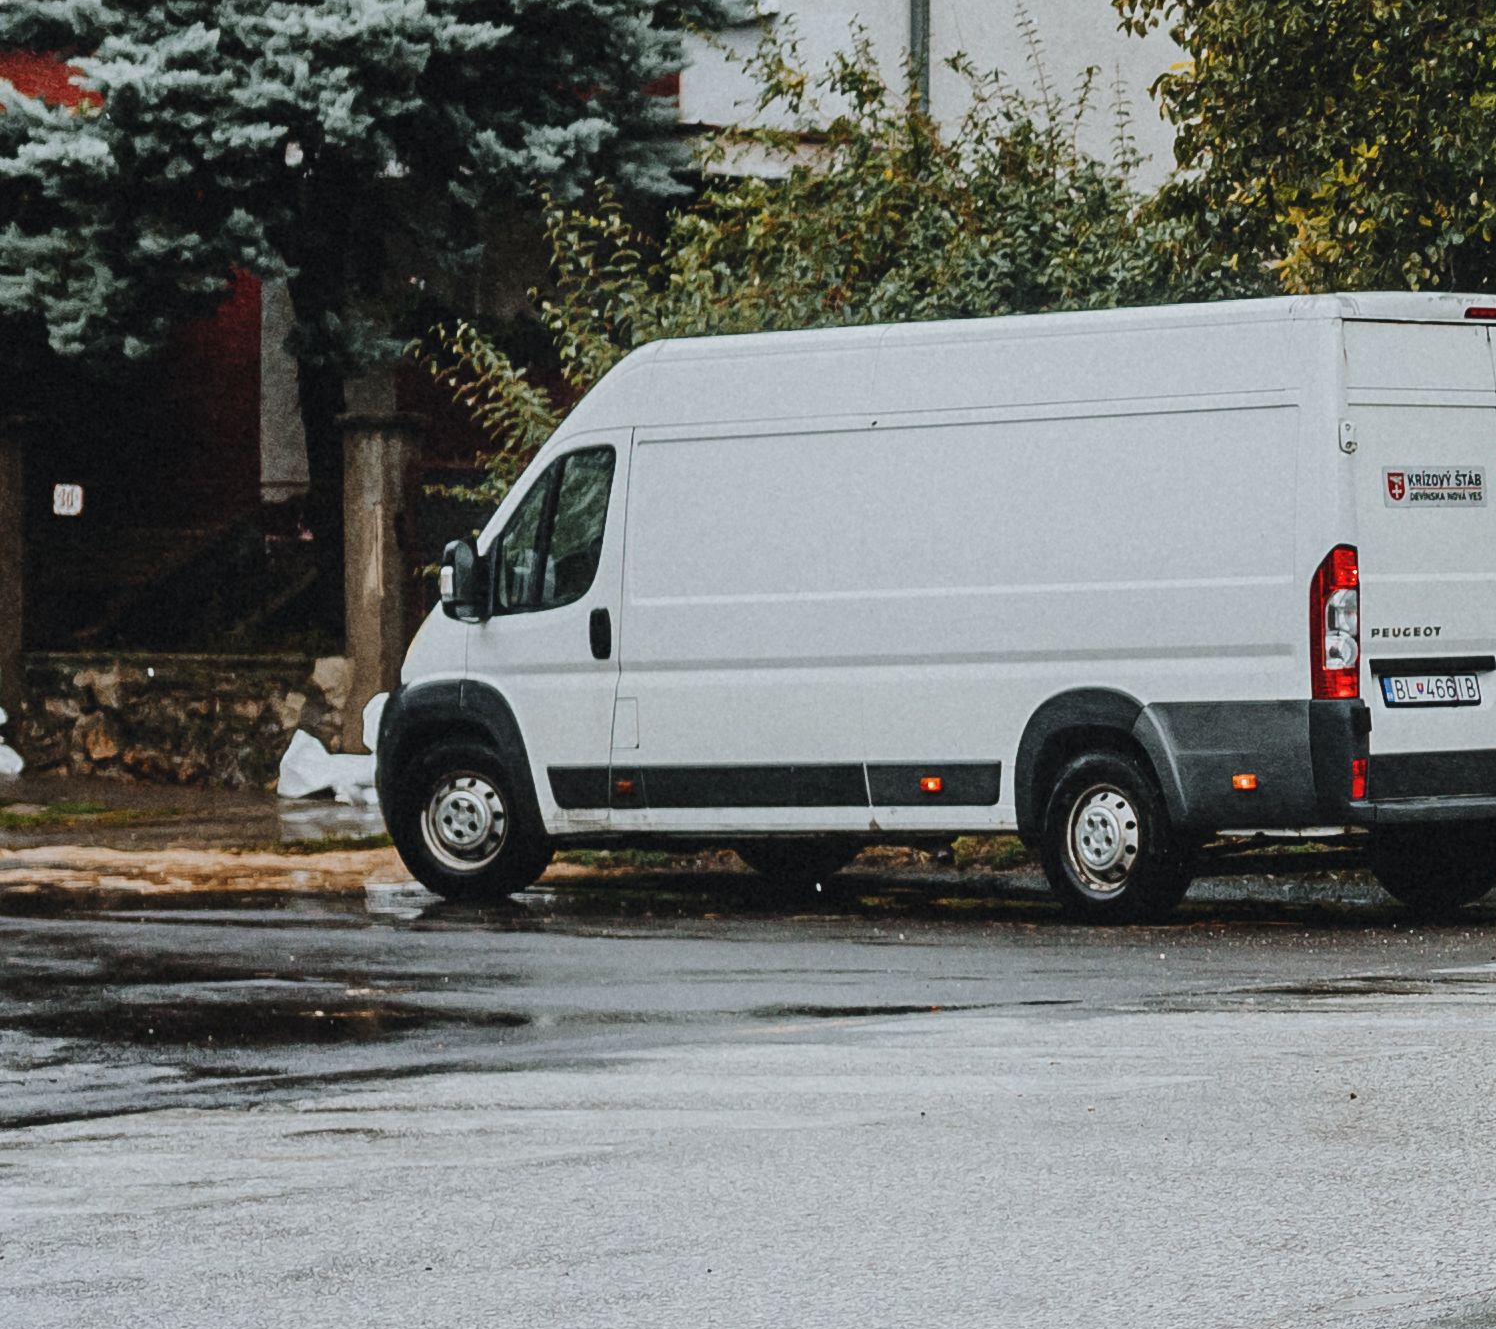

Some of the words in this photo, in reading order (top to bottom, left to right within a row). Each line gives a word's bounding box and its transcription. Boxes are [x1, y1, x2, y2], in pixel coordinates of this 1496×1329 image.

[1407, 470, 1452, 486] KRÍZOVÝ
[1455, 470, 1482, 486] ŠTÁB
[1468, 491, 1483, 501] VES
[1371, 626, 1442, 638] PEUGEOT
[1394, 678, 1418, 700] BL
